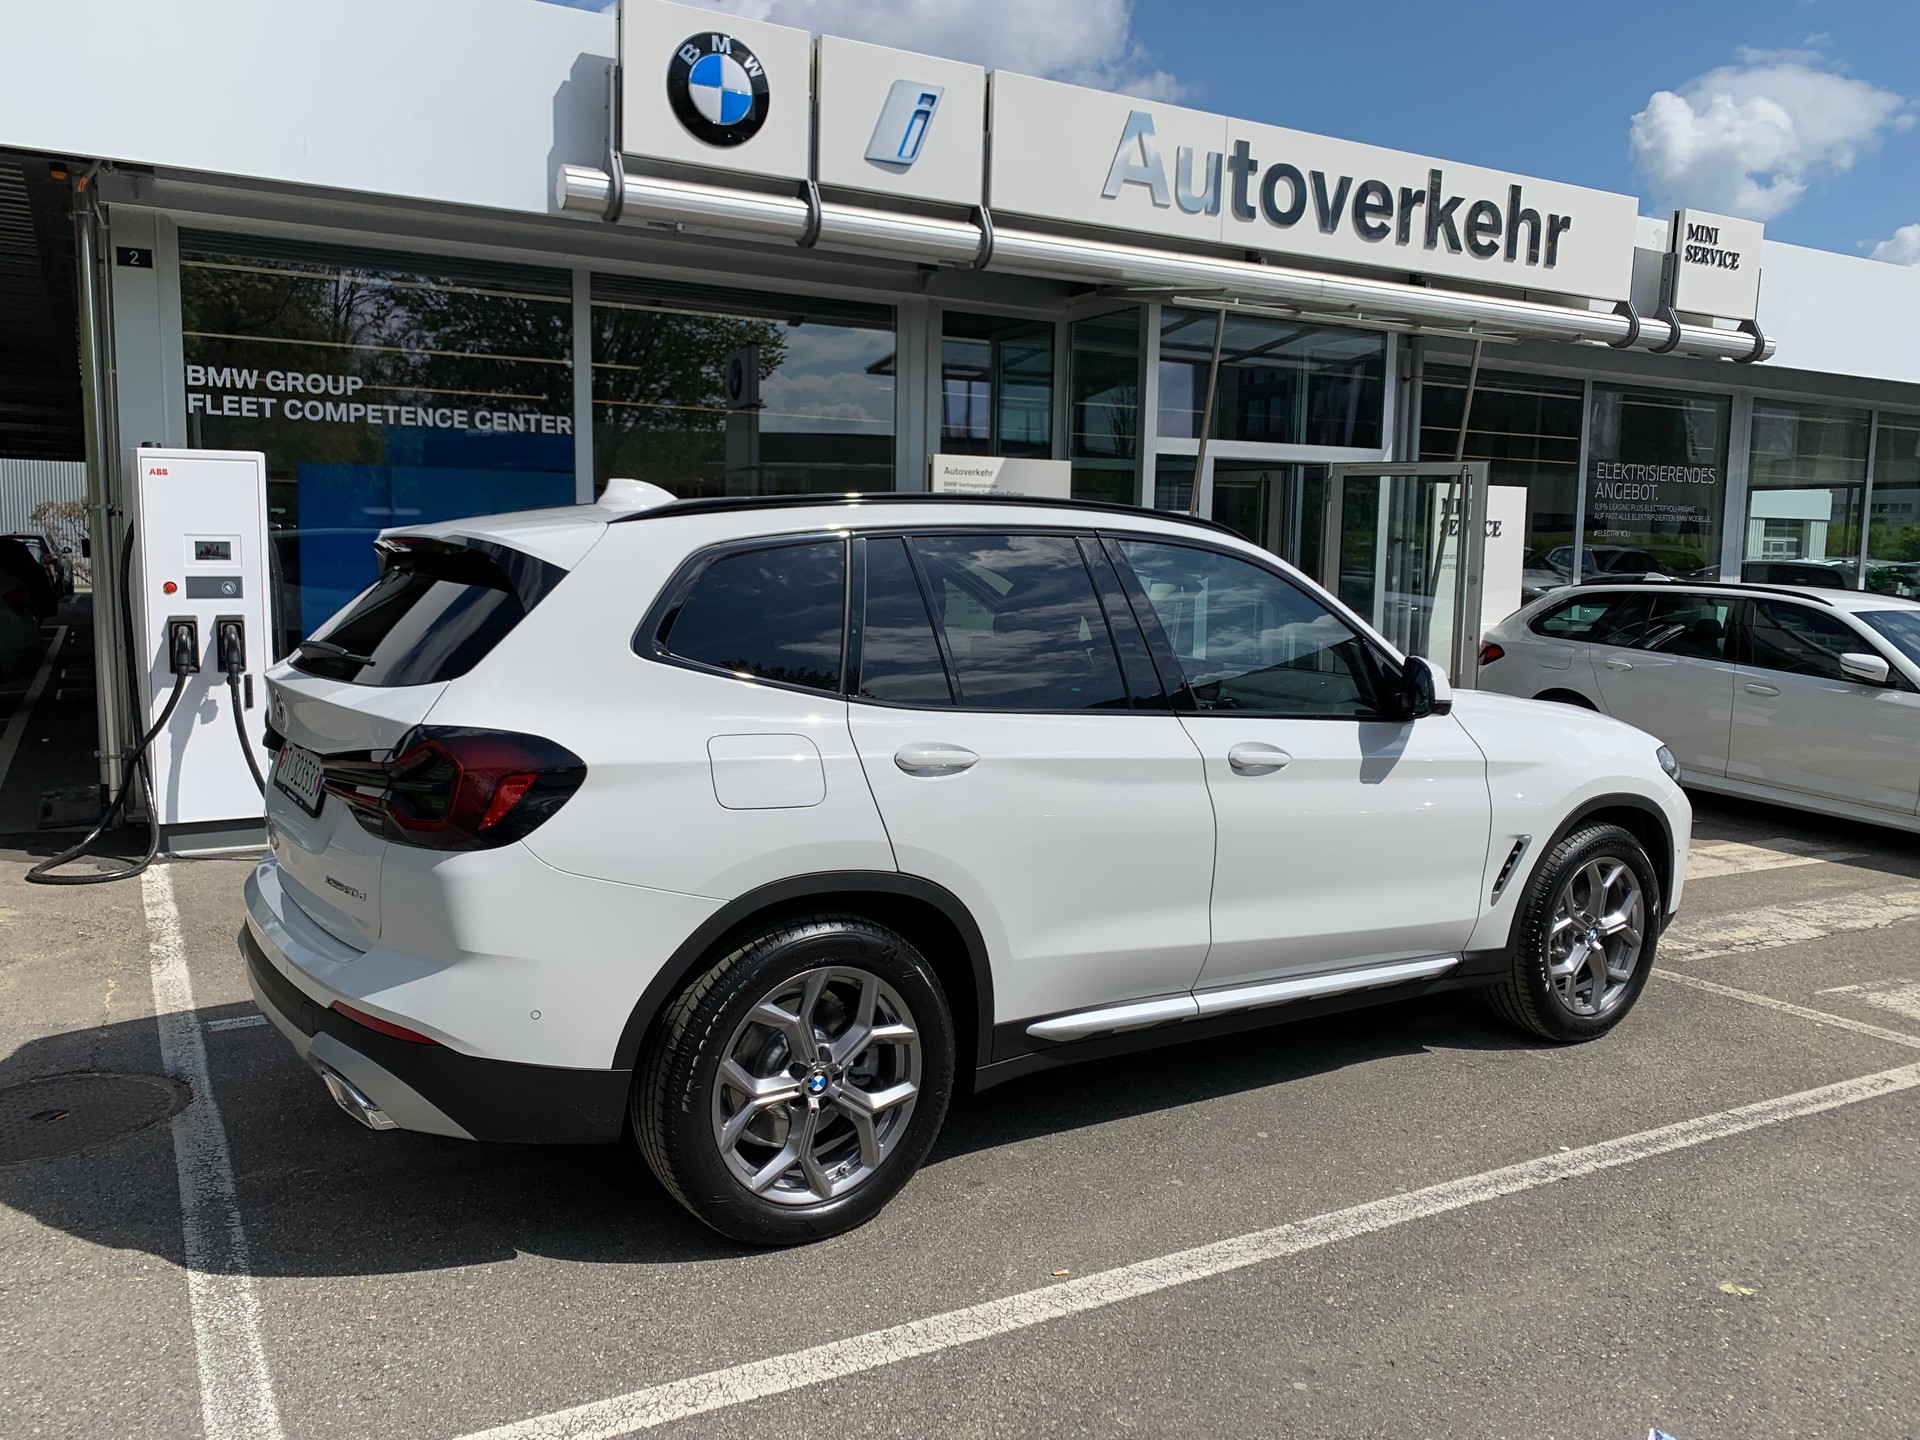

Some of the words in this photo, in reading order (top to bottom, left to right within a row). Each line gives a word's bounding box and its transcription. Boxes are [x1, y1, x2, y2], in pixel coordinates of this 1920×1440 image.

[679, 35, 763, 77] BMW
[1101, 109, 1571, 268] Autoverkehr
[1686, 223, 1720, 245] MINI
[130, 251, 139, 264] 2
[1684, 244, 1740, 271] SERVICE
[186, 365, 258, 389] BMW
[265, 370, 363, 396] GROUP
[187, 394, 277, 418] FLEET
[284, 399, 469, 429] COMPETENCE
[474, 410, 573, 435] CENTER
[149, 468, 168, 476] ABB
[943, 467, 994, 477] Autoverkehr
[1597, 462, 1716, 484] ELEKTRISIERENDES
[1595, 482, 1659, 500] ANGEBOT.
